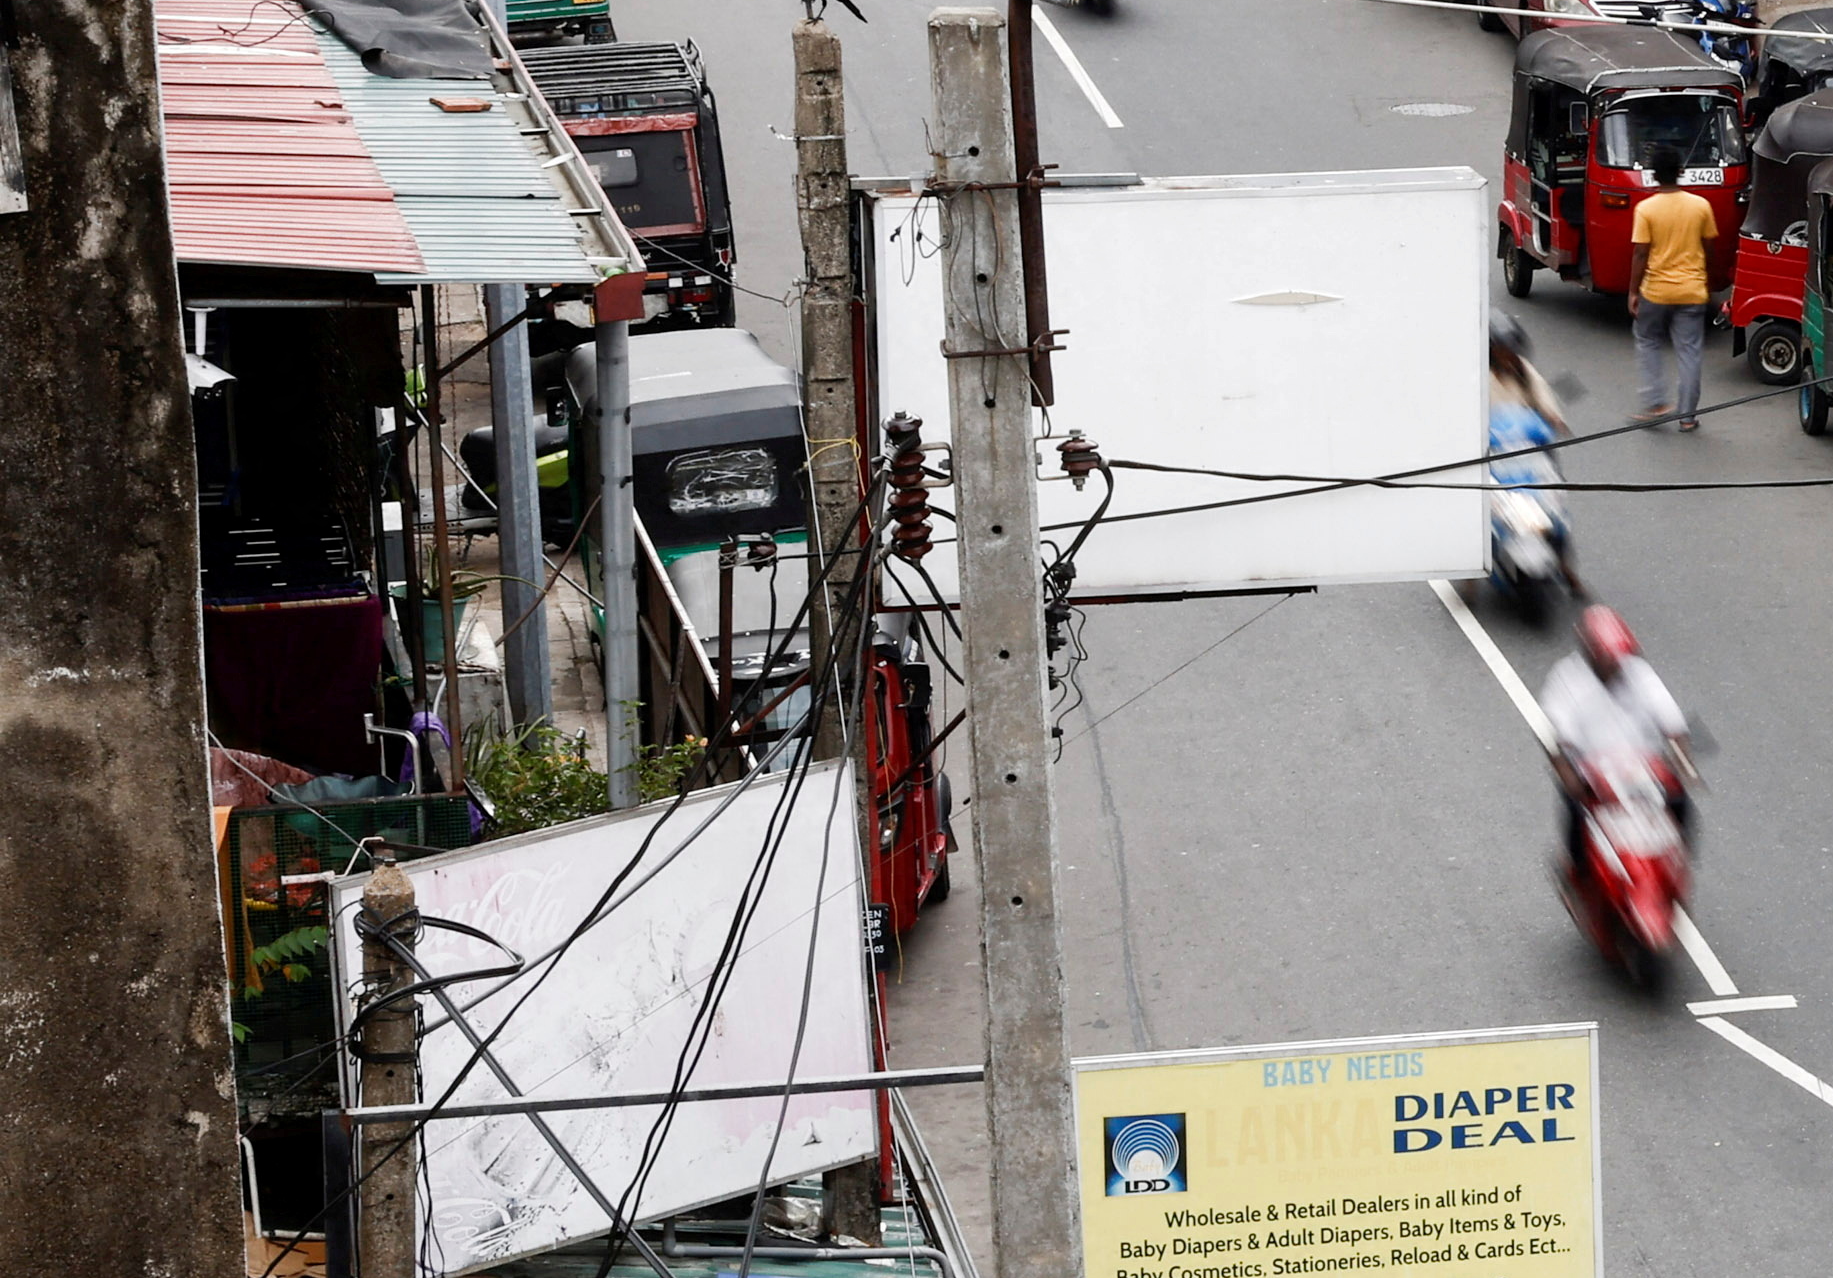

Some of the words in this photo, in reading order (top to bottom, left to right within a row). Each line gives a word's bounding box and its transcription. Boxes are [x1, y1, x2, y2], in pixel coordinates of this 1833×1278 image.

[1689, 170, 1722, 183] 3428
[1263, 1059, 1332, 1088] BABY
[1346, 1052, 1424, 1081] NEEDS
[1394, 1083, 1575, 1122] DIAPER
[1393, 1118, 1576, 1153] DEAL
[1125, 1178, 1171, 1194] LDD
[1165, 1205, 1261, 1228] Wholesale
[1266, 1204, 1279, 1221] &
[1285, 1198, 1337, 1220] Retail
[1342, 1195, 1409, 1216] Dealers
[1414, 1193, 1431, 1210] in
[1435, 1189, 1457, 1208] all
[1462, 1186, 1499, 1207] kind
[1504, 1184, 1522, 1203] of
[1120, 1239, 1167, 1262] Baby
[1173, 1236, 1242, 1259] Diapers
[1247, 1233, 1260, 1250] &
[1265, 1228, 1315, 1249] Adult
[1321, 1225, 1394, 1247] Diapers,
[1399, 1219, 1444, 1240] Baby
[1450, 1216, 1499, 1234] Items
[1503, 1212, 1516, 1230] &
[1520, 1211, 1567, 1233] Toys,
[1272, 1252, 1386, 1276] Stationeries,
[1391, 1244, 1451, 1266] Reload
[1457, 1244, 1470, 1261] &
[1475, 1238, 1525, 1258] Cards
[1529, 1238, 1571, 1255] Ect...
